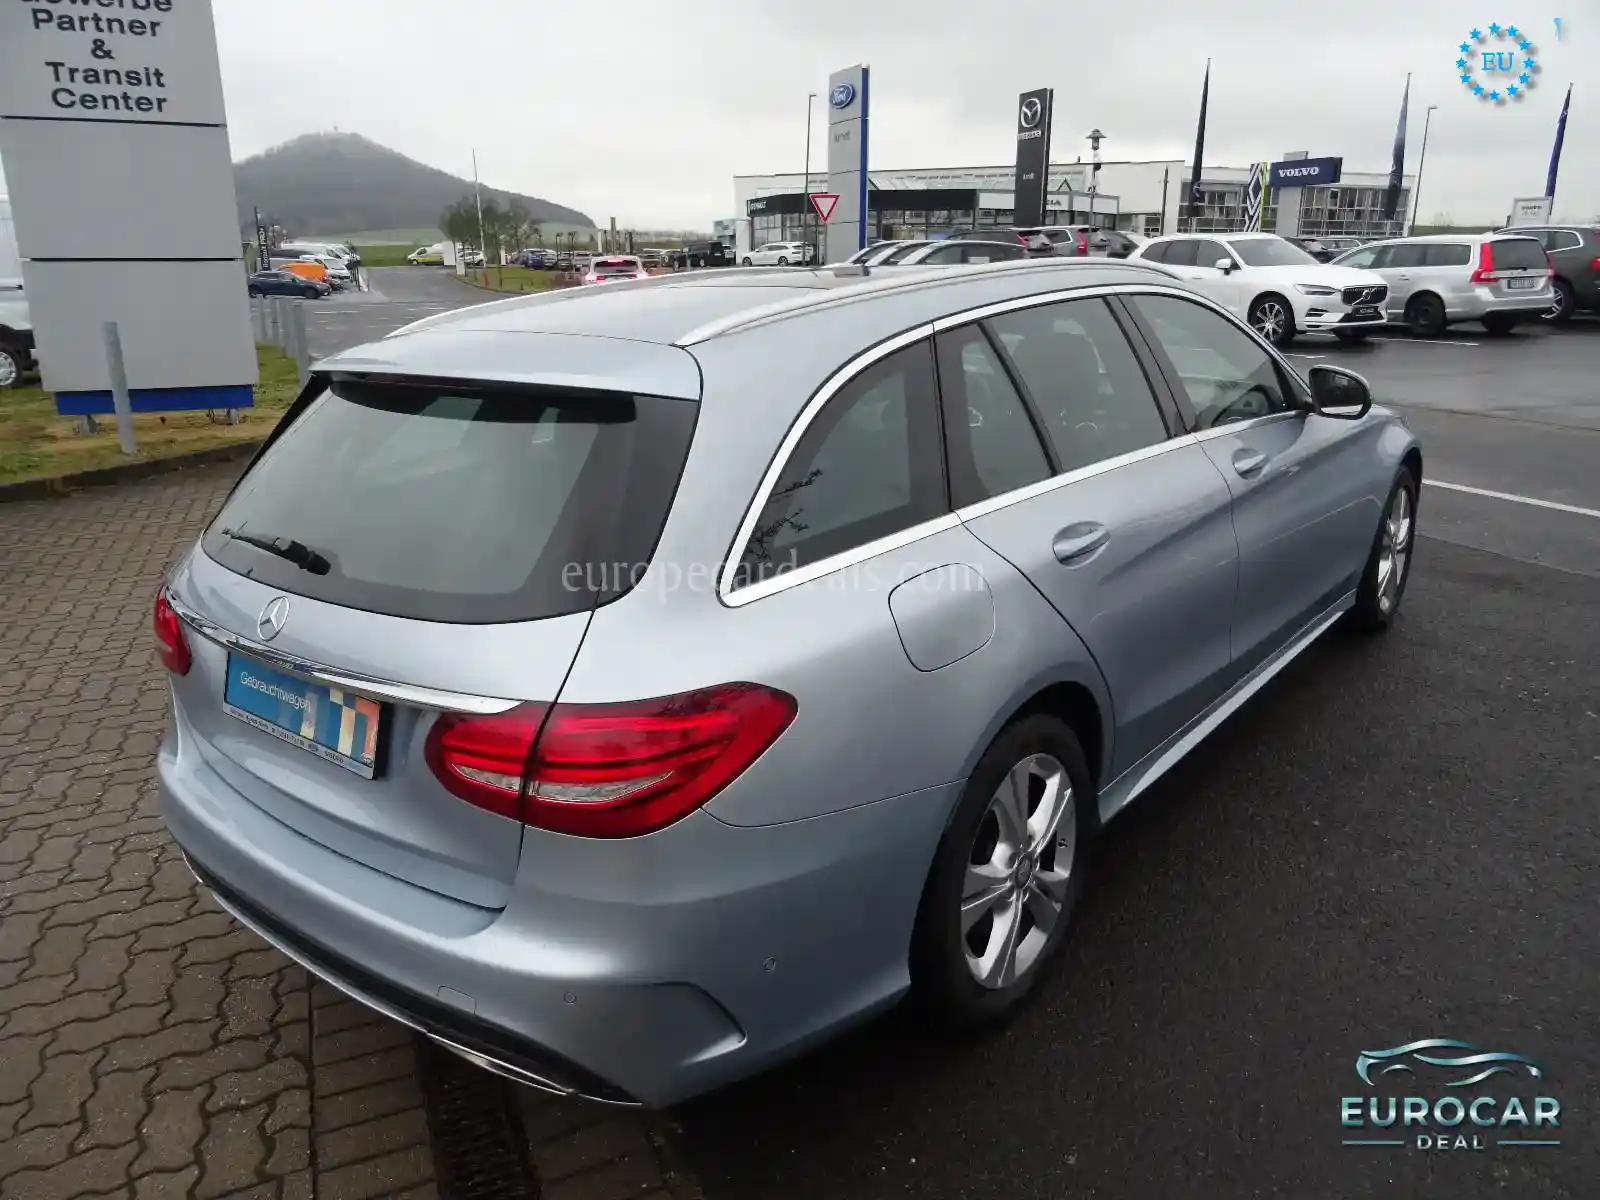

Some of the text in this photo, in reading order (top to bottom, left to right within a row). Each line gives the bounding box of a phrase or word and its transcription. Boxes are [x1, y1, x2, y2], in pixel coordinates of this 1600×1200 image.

[32, 8, 161, 37] Partner
[91, 38, 115, 60] &
[45, 61, 166, 88] Transit
[51, 88, 167, 113] Center
[1279, 166, 1319, 178] VOLVO
